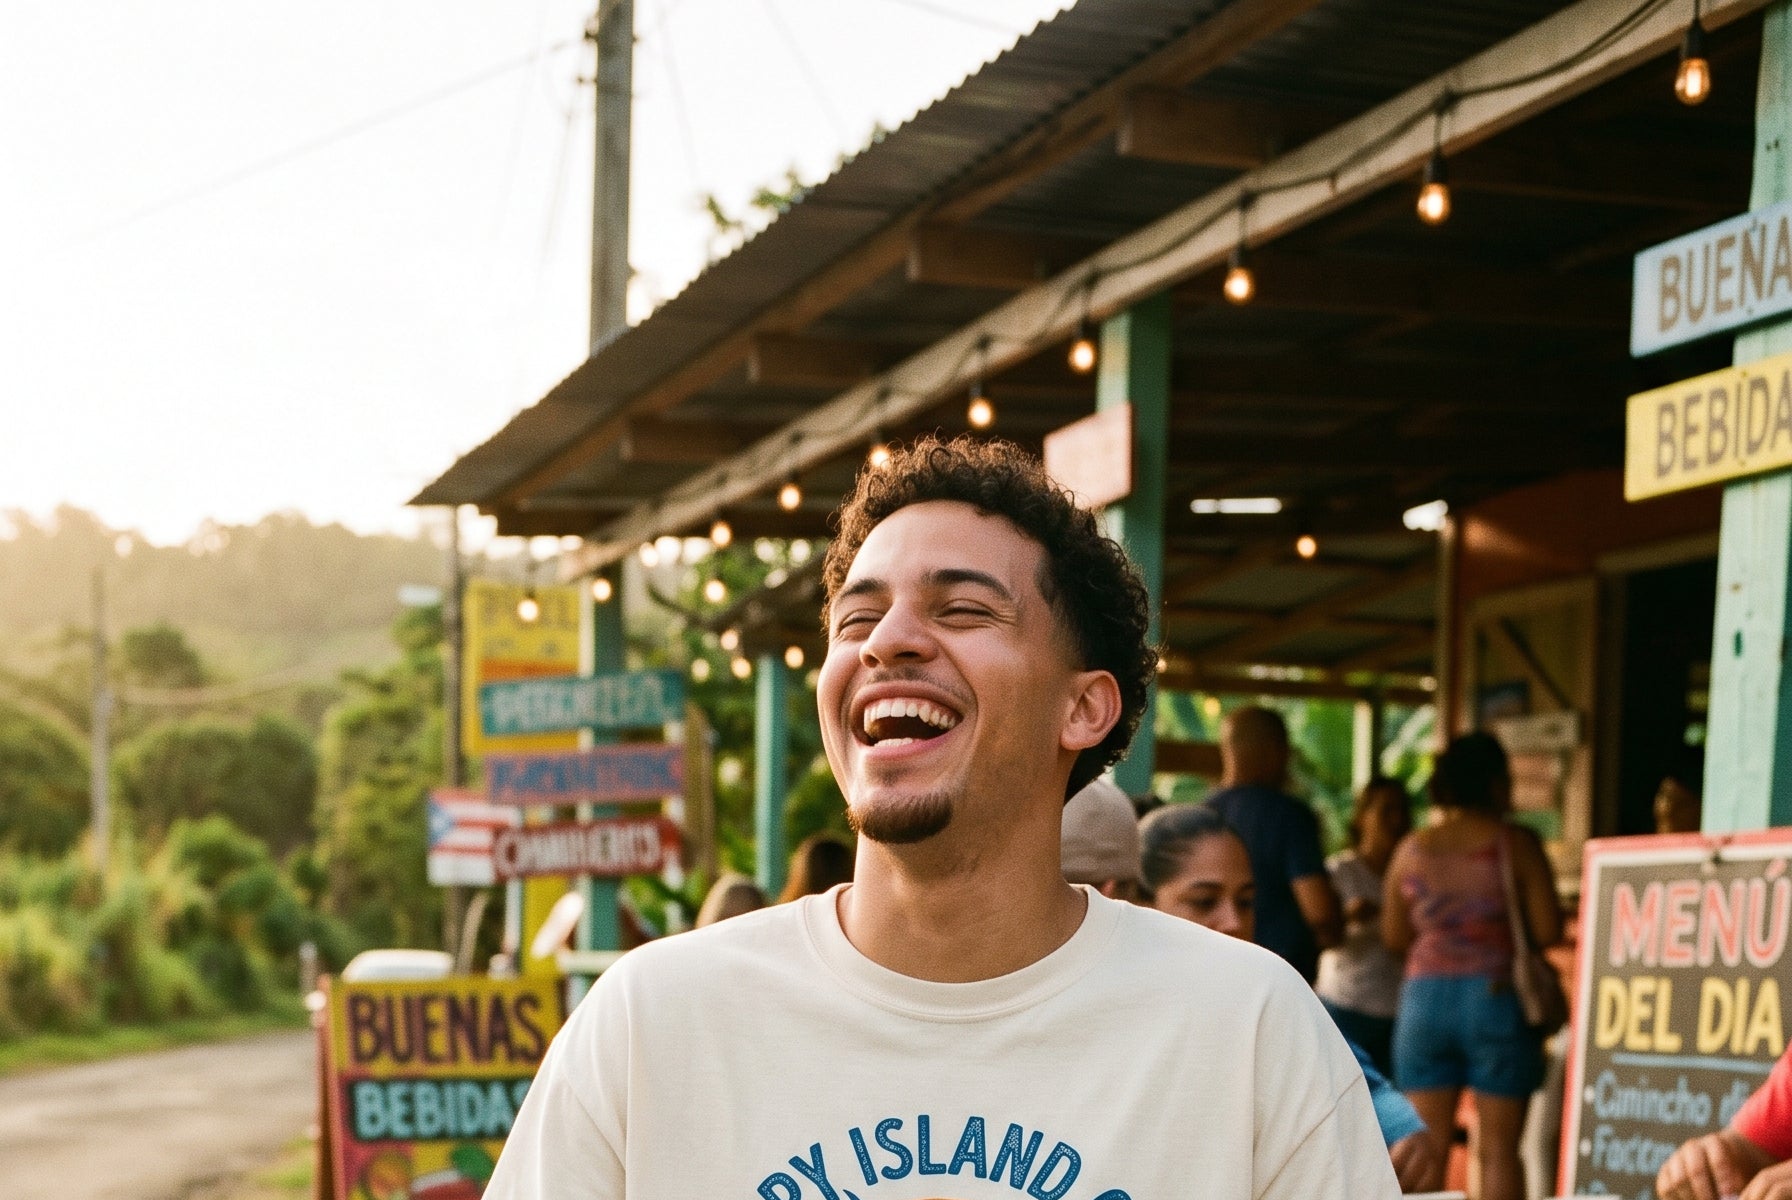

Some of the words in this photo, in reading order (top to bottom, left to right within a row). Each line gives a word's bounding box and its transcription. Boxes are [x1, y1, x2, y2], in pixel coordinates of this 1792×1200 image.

[1609, 858, 1791, 967] MENÚ
[348, 991, 545, 1065] BUENAS
[1594, 976, 1682, 1052] DEL
[1696, 976, 1784, 1056] DIA
